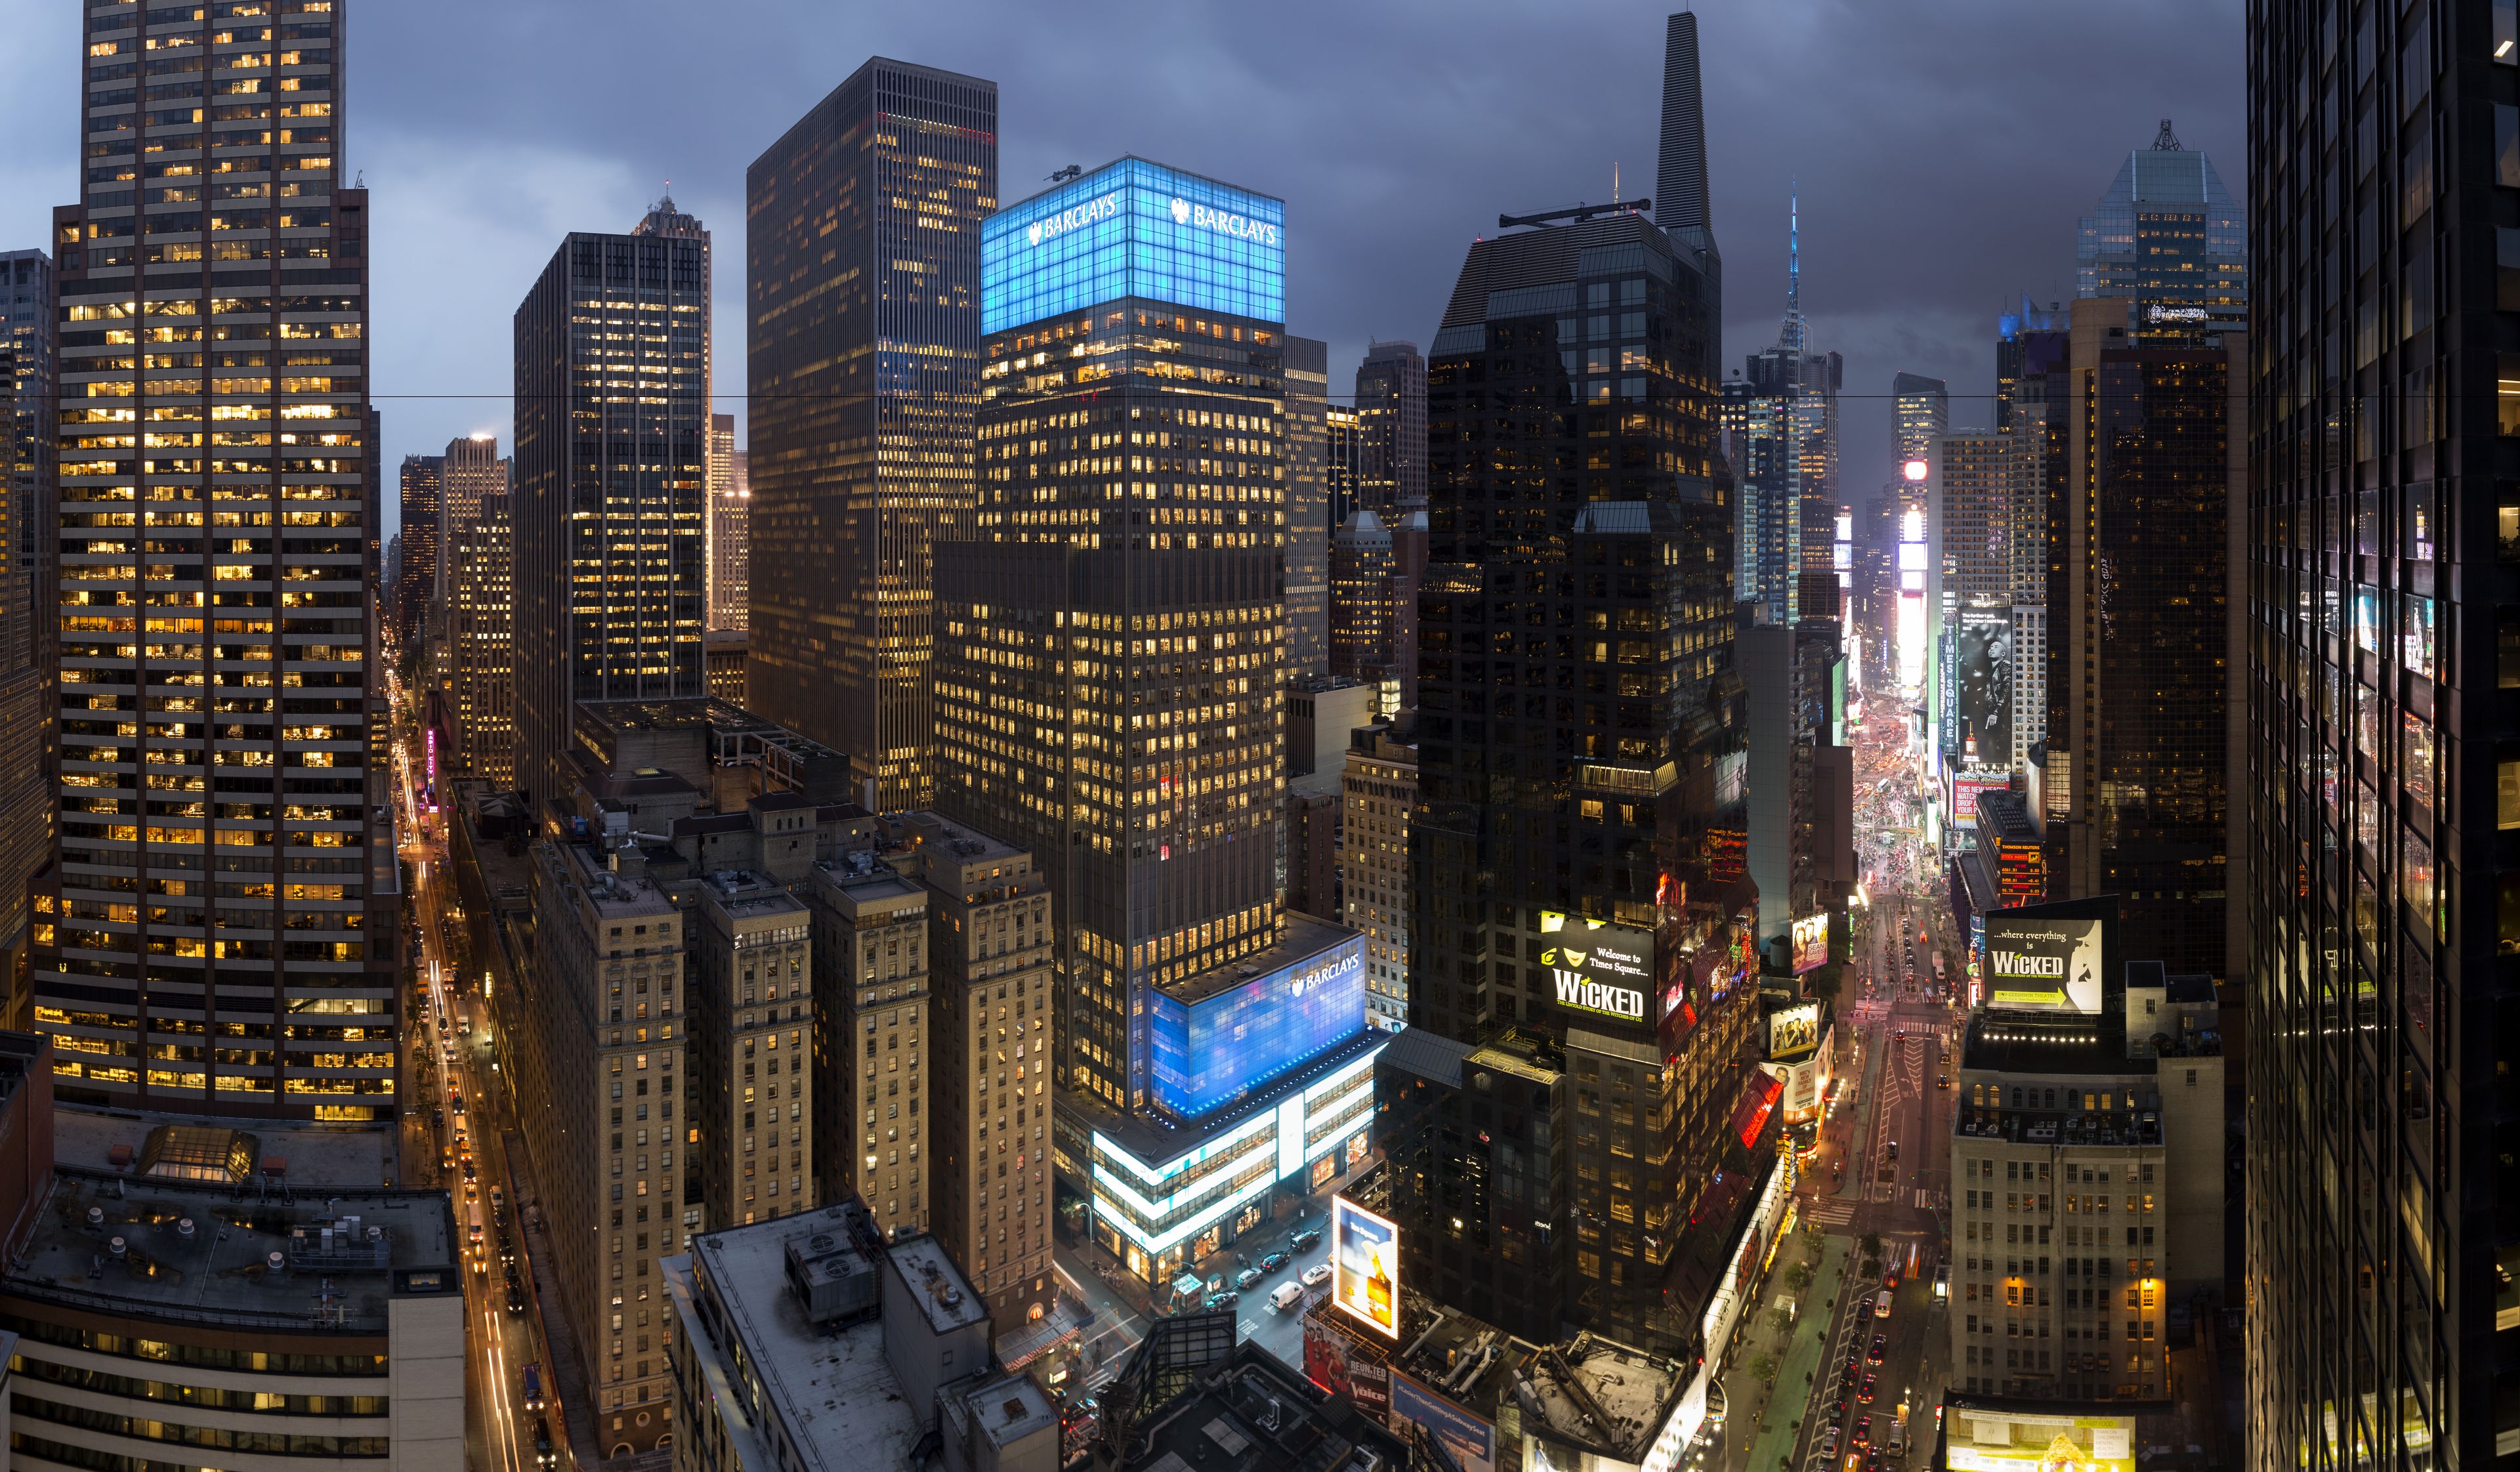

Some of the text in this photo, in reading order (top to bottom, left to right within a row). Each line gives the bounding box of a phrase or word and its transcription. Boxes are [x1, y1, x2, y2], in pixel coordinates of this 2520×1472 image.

[1045, 193, 1116, 239] BARCLAYS
[1194, 204, 1276, 244] BARCLAYS
[1945, 626, 1954, 738] TIMES SQUARE
[2026, 931, 2067, 942] everything
[1589, 957, 1613, 970] Times
[1597, 947, 1641, 963] Welcome to
[1306, 953, 1358, 990] BARCLAYS
[1610, 1011, 1629, 1020] WITCHES
[1796, 1087, 1815, 1096] COMEDIES
[1796, 1096, 1815, 1106] THURSDAYS
[1351, 1381, 1386, 1402] Voice
[1398, 1385, 1485, 1437] #EasierThanGettingASubwaySeat
